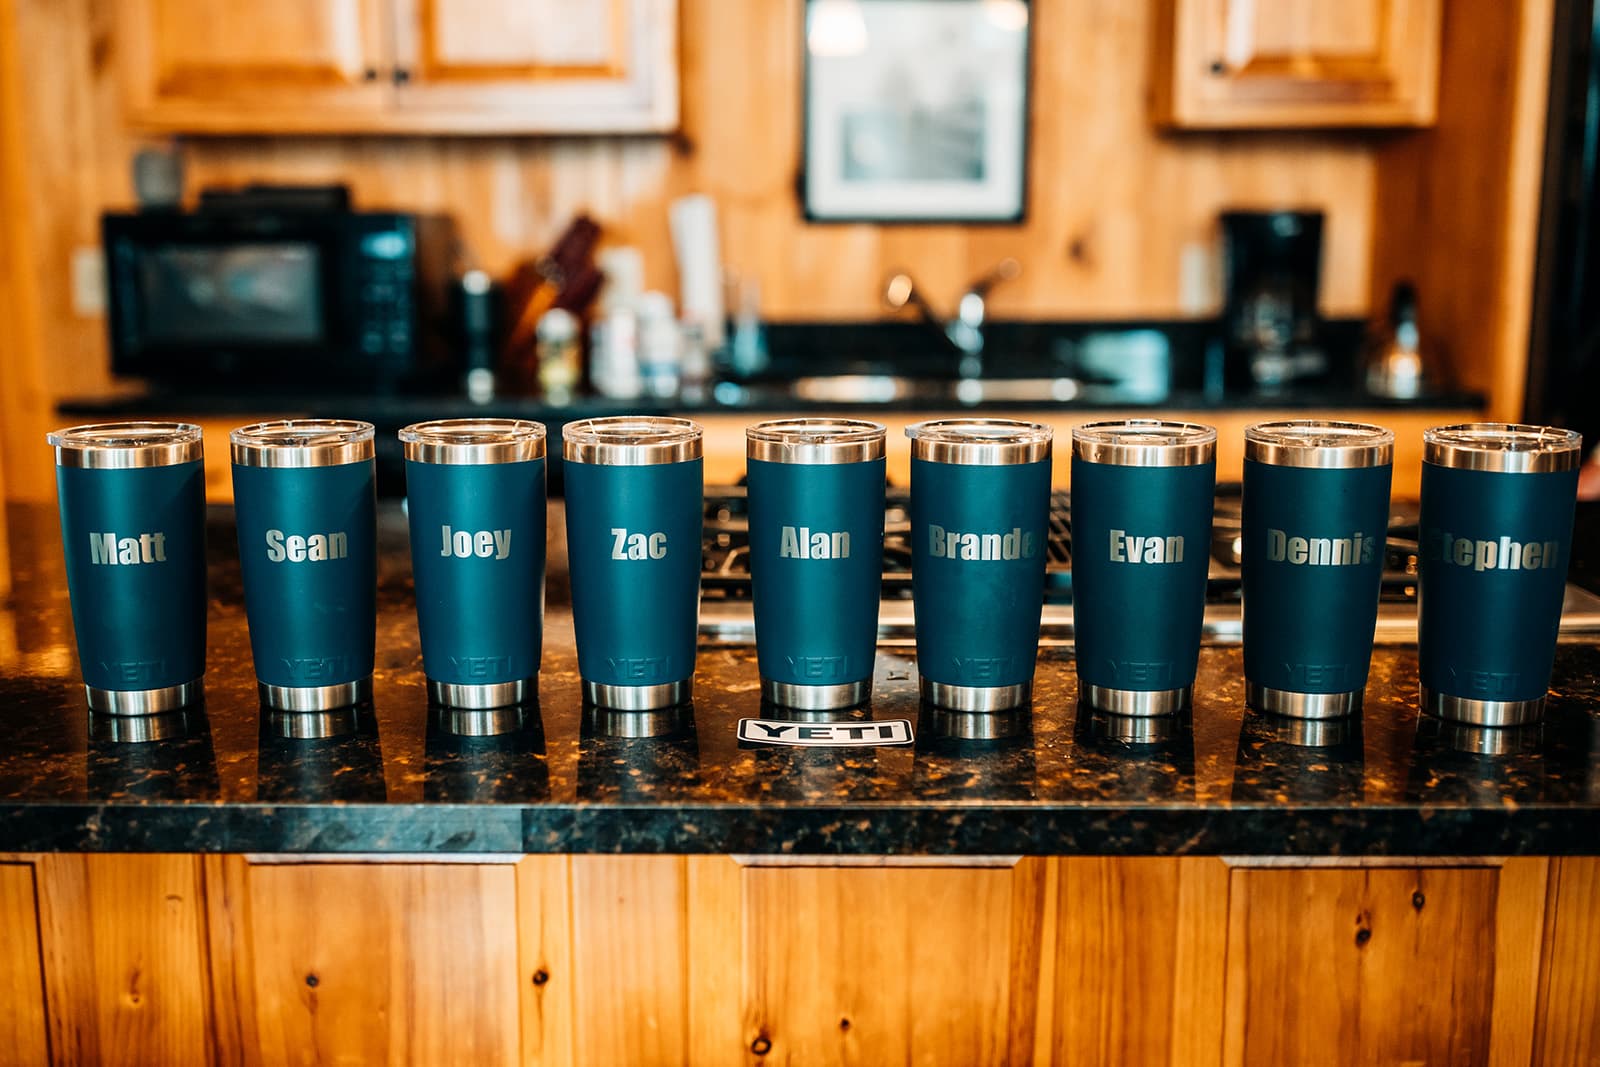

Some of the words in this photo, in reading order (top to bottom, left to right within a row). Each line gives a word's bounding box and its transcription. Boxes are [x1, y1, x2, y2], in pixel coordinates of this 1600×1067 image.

[90, 531, 166, 565] Matt
[266, 529, 348, 563] Sean
[441, 525, 512, 560] Joey
[611, 528, 668, 560] Zac
[780, 526, 850, 560] Alan
[1109, 529, 1185, 564] Evan
[1267, 528, 1373, 565] Dennis
[785, 656, 848, 678] YETI
[754, 723, 893, 739] YETI
